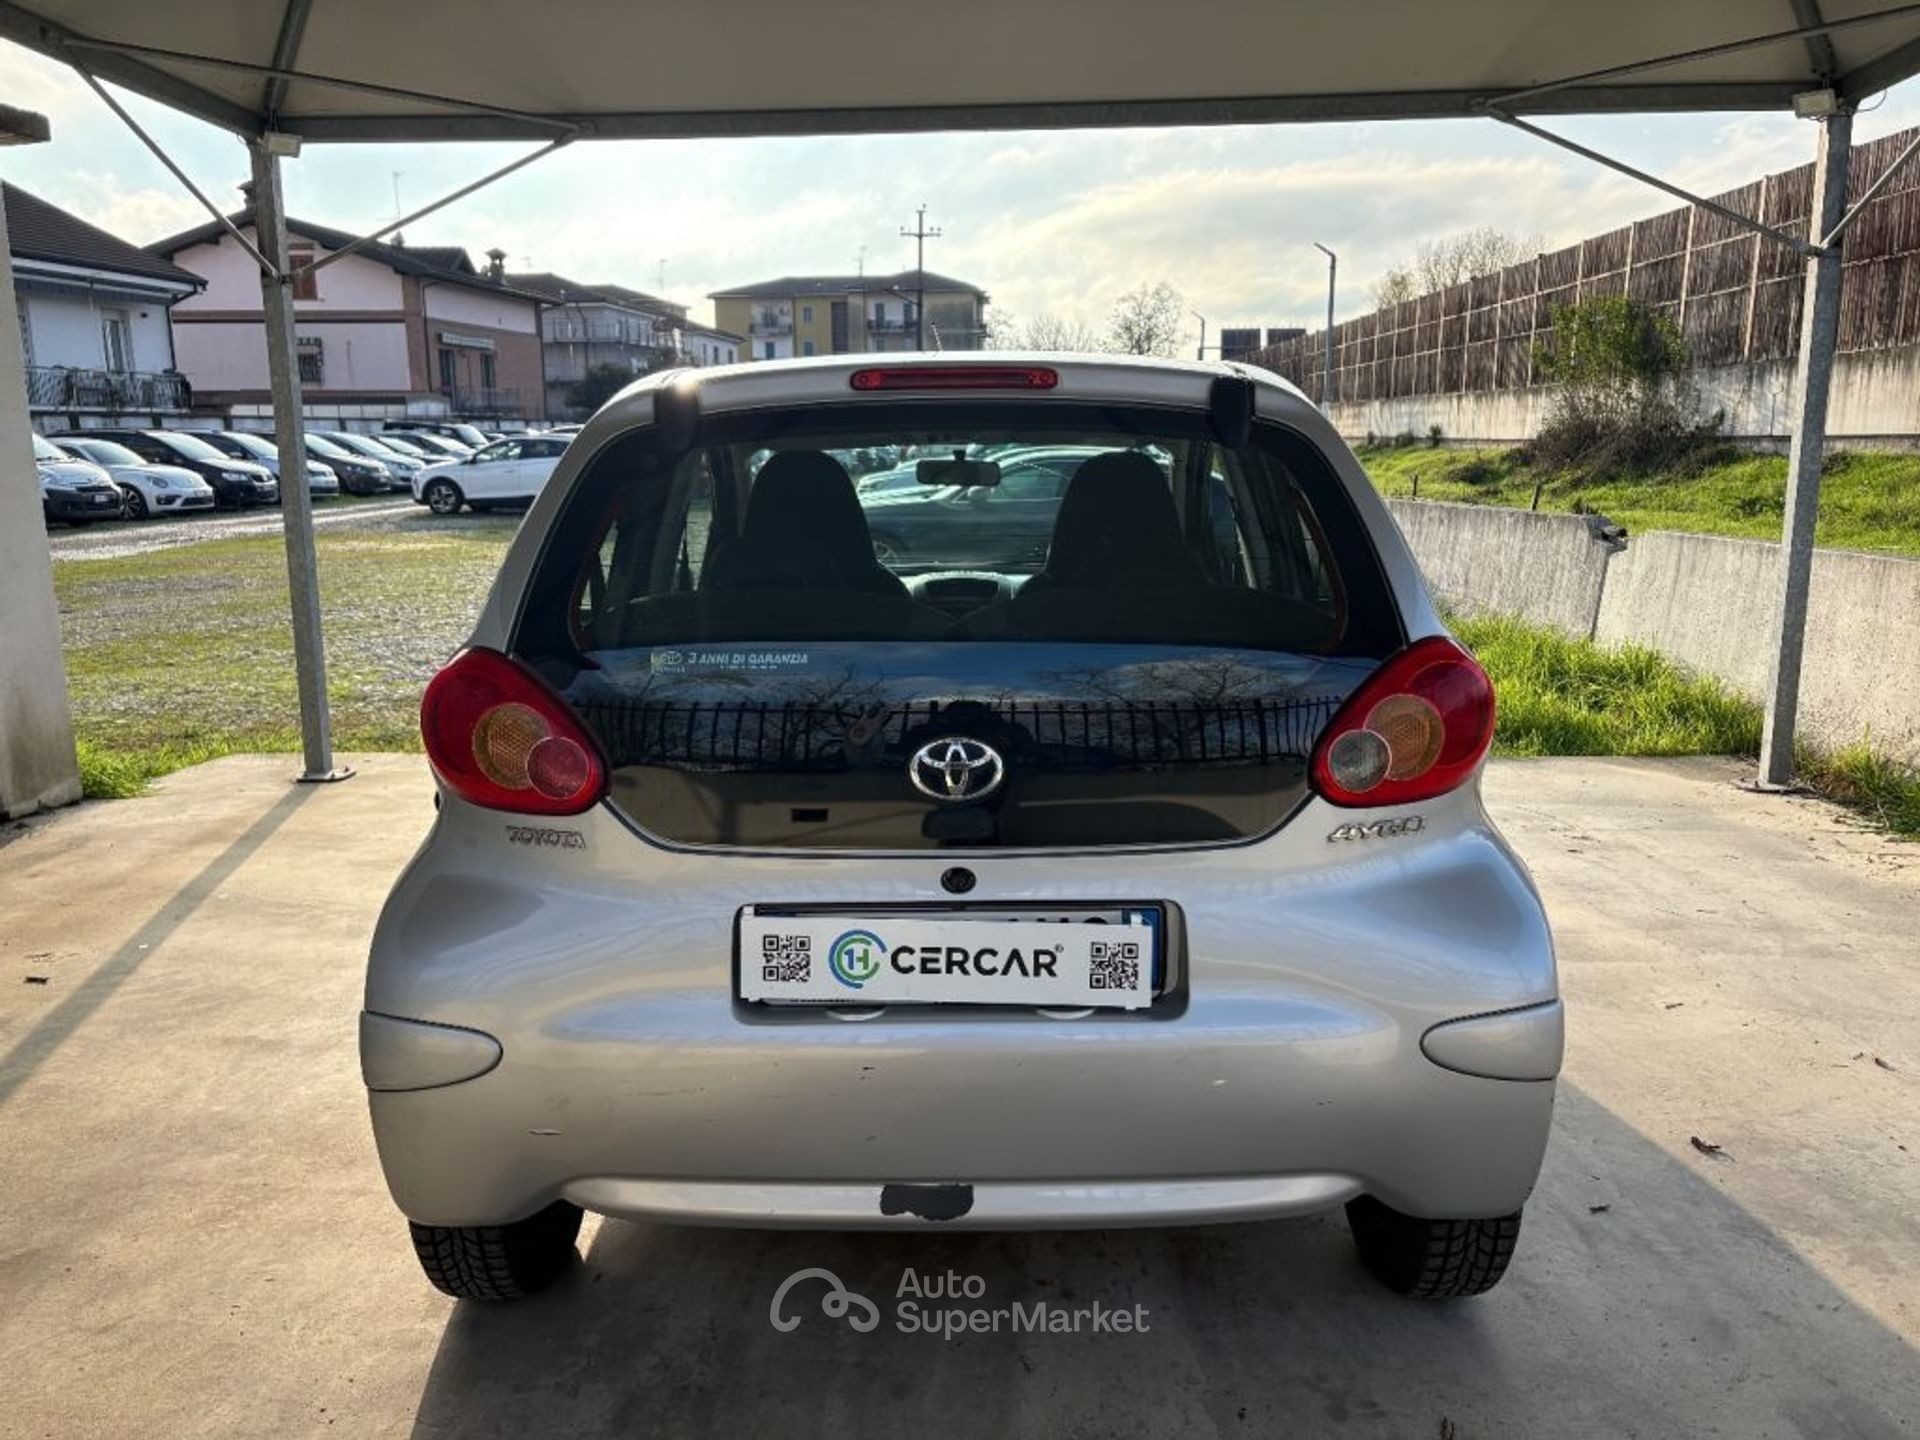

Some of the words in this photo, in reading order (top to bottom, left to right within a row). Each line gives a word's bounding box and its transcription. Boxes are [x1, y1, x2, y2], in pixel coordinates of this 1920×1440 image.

[688, 652, 697, 664] 3
[699, 653, 729, 665] ANNI
[732, 653, 746, 664] DI
[748, 653, 808, 665] GARANZIA
[506, 825, 586, 849] TOYOTA
[1327, 816, 1425, 842] AYGO
